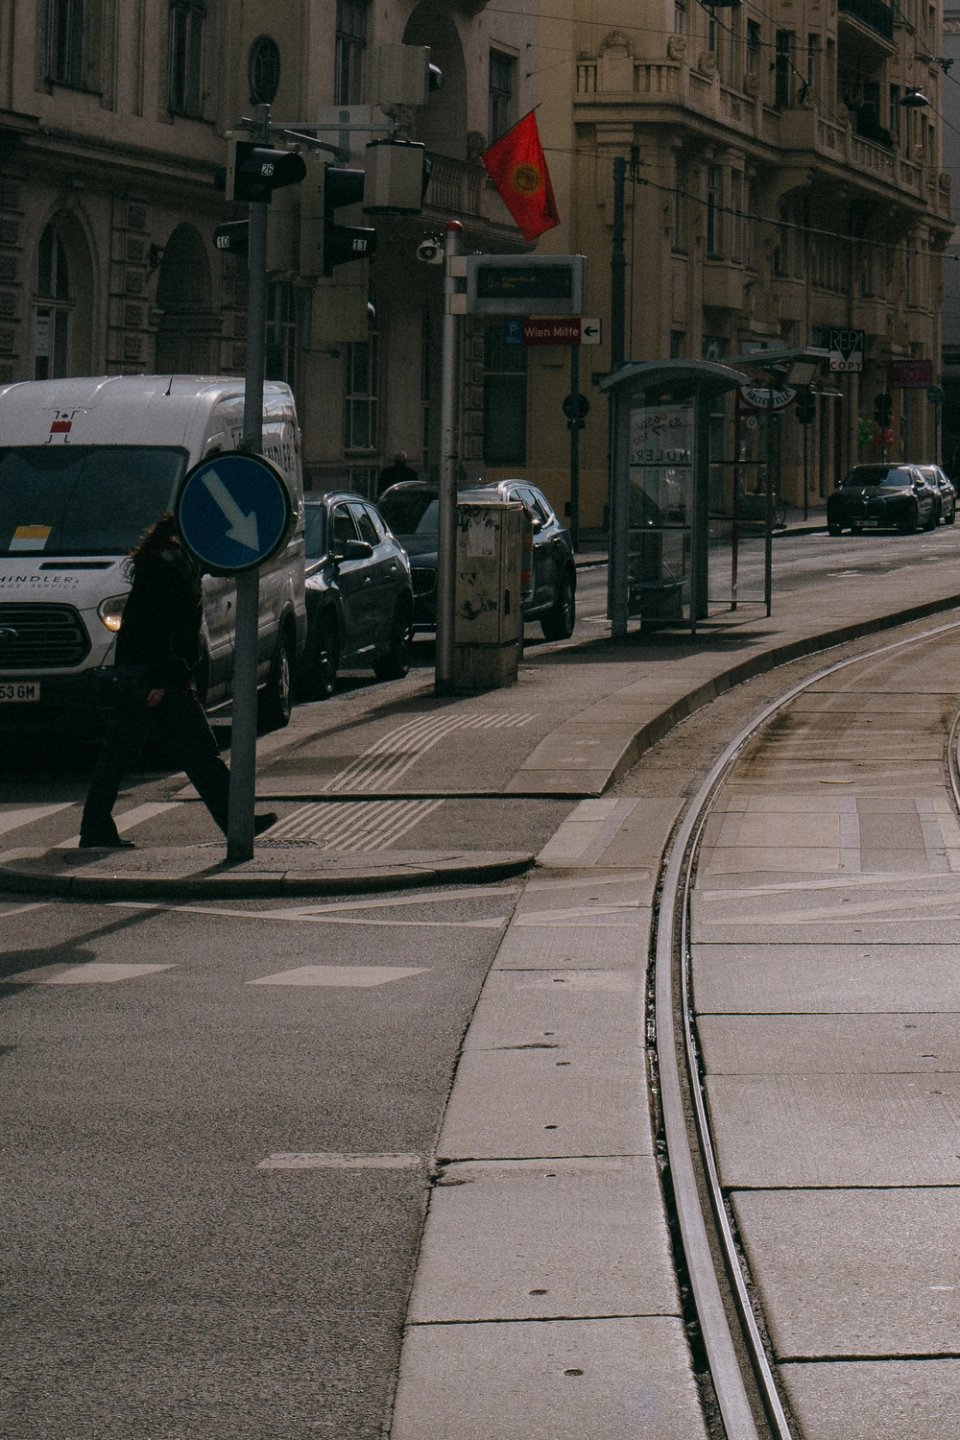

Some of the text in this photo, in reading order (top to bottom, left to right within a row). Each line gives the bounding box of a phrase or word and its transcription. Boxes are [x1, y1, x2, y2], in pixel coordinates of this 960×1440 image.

[524, 327, 550, 337] Wien
[553, 326, 579, 337] Mitte
[831, 361, 862, 370] COPY
[747, 390, 791, 406] HALTESELLE
